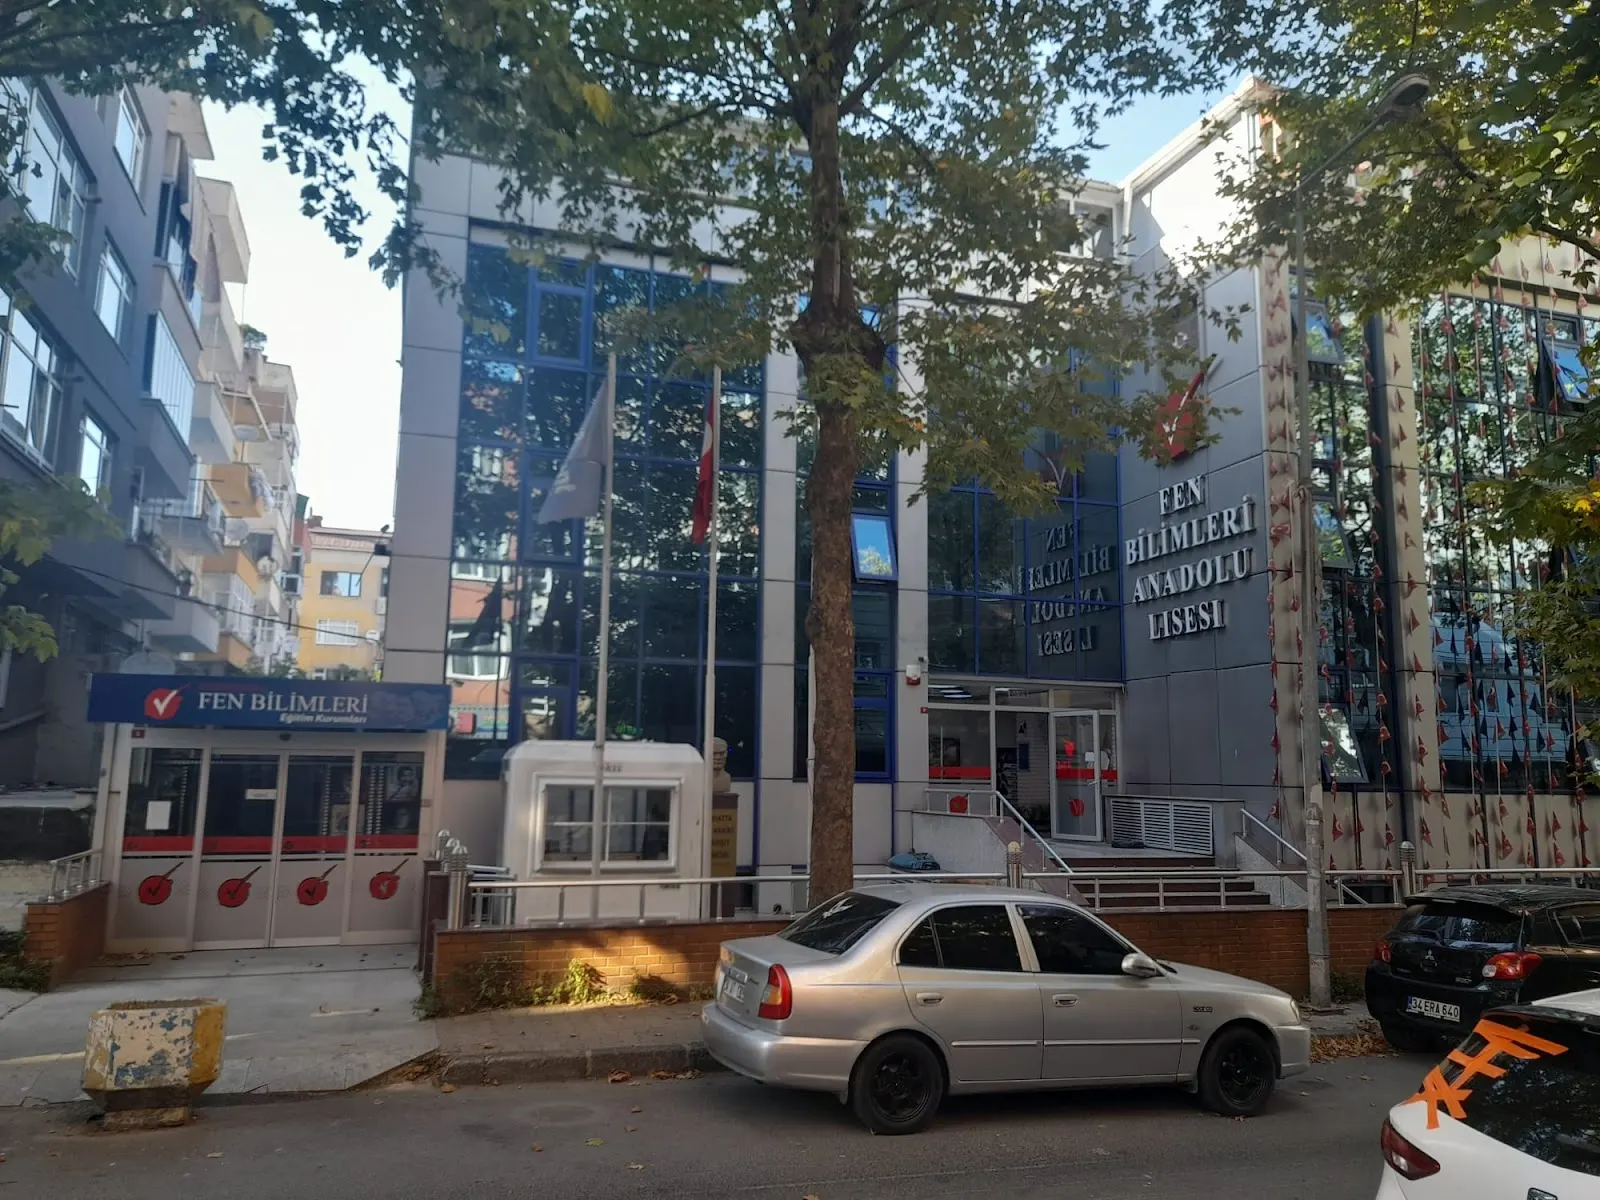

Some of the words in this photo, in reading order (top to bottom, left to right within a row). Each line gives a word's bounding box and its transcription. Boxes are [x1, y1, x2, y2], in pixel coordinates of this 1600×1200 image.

[1158, 476, 1203, 515] FEN
[1124, 494, 1256, 566] BİLİMLERİ
[1132, 547, 1252, 603] ANADOLU
[198, 691, 245, 711] FEN
[250, 690, 369, 714] BİLİMLERİ
[1412, 998, 1423, 1010] 34
[1424, 1001, 1441, 1014] ERA
[1442, 1004, 1460, 1019] 640
